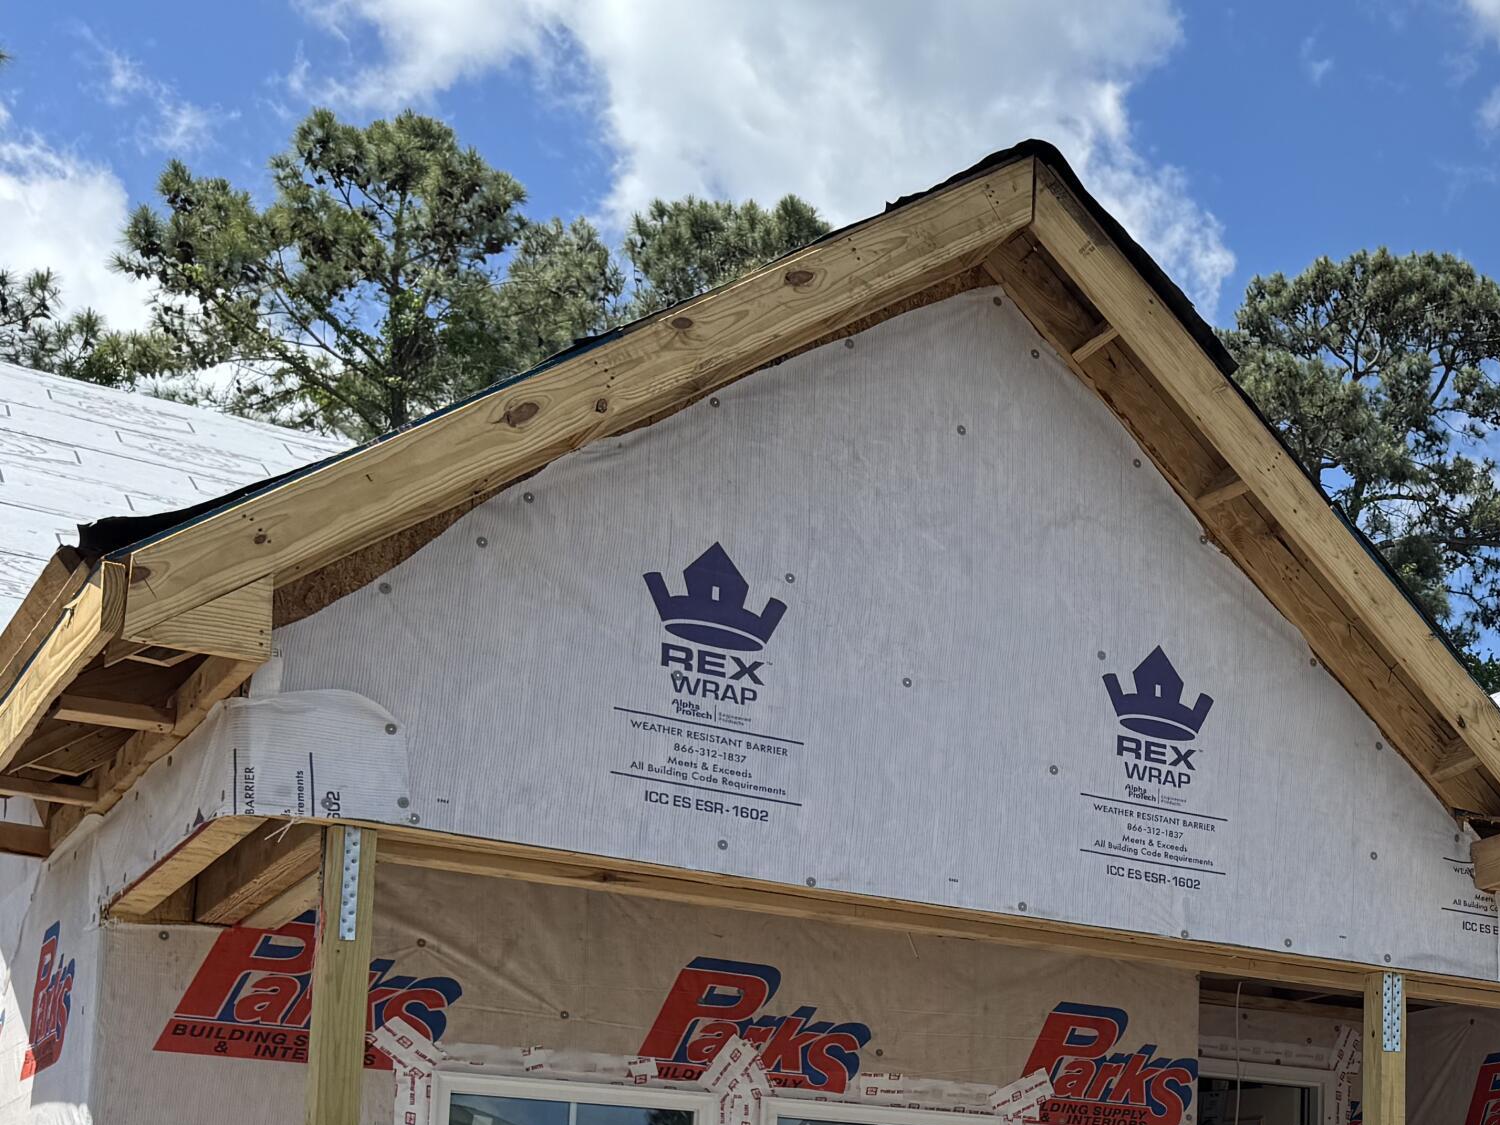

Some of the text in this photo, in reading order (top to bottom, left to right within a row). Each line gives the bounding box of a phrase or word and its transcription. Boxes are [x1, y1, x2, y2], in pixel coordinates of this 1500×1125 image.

[661, 643, 764, 686] REX
[671, 673, 757, 705] WRAP
[672, 699, 700, 710] Alpha
[676, 707, 712, 720] ProTech
[631, 720, 788, 756] WEATHER RESISTANT BARRIER
[674, 743, 746, 763] 866-312-1837
[1117, 735, 1196, 770] REX
[631, 762, 786, 795] All Building Code Requirements
[667, 757, 752, 778] Meets & Exceeds
[1125, 762, 1190, 788] WRAP
[245, 767, 254, 814] BARRIER
[1125, 784, 1147, 794] Alpha
[645, 790, 768, 821] ICC ES ESR-1602
[1094, 804, 1215, 832] WEATHER RESISTANT BARRIER
[1127, 823, 1183, 839] 866-312-1837
[1109, 842, 1138, 855] Building
[1141, 848, 1161, 857] Code
[1164, 852, 1213, 866] Requirements
[1122, 835, 1145, 845] Meets
[1157, 841, 1187, 852] Exceeds
[1107, 865, 1200, 889] ICC ES ESR-1602
[1464, 901, 1487, 911] Building
[1463, 921, 1477, 931] ICC
[1480, 924, 1490, 934] ES
[29, 920, 75, 1046] Parks
[171, 1024, 289, 1046] BUILDING
[214, 1041, 228, 1053] &
[1022, 1002, 1198, 1116] Parks
[1040, 1112, 1049, 1122] &
[1093, 1105, 1147, 1119] SUPPLY
